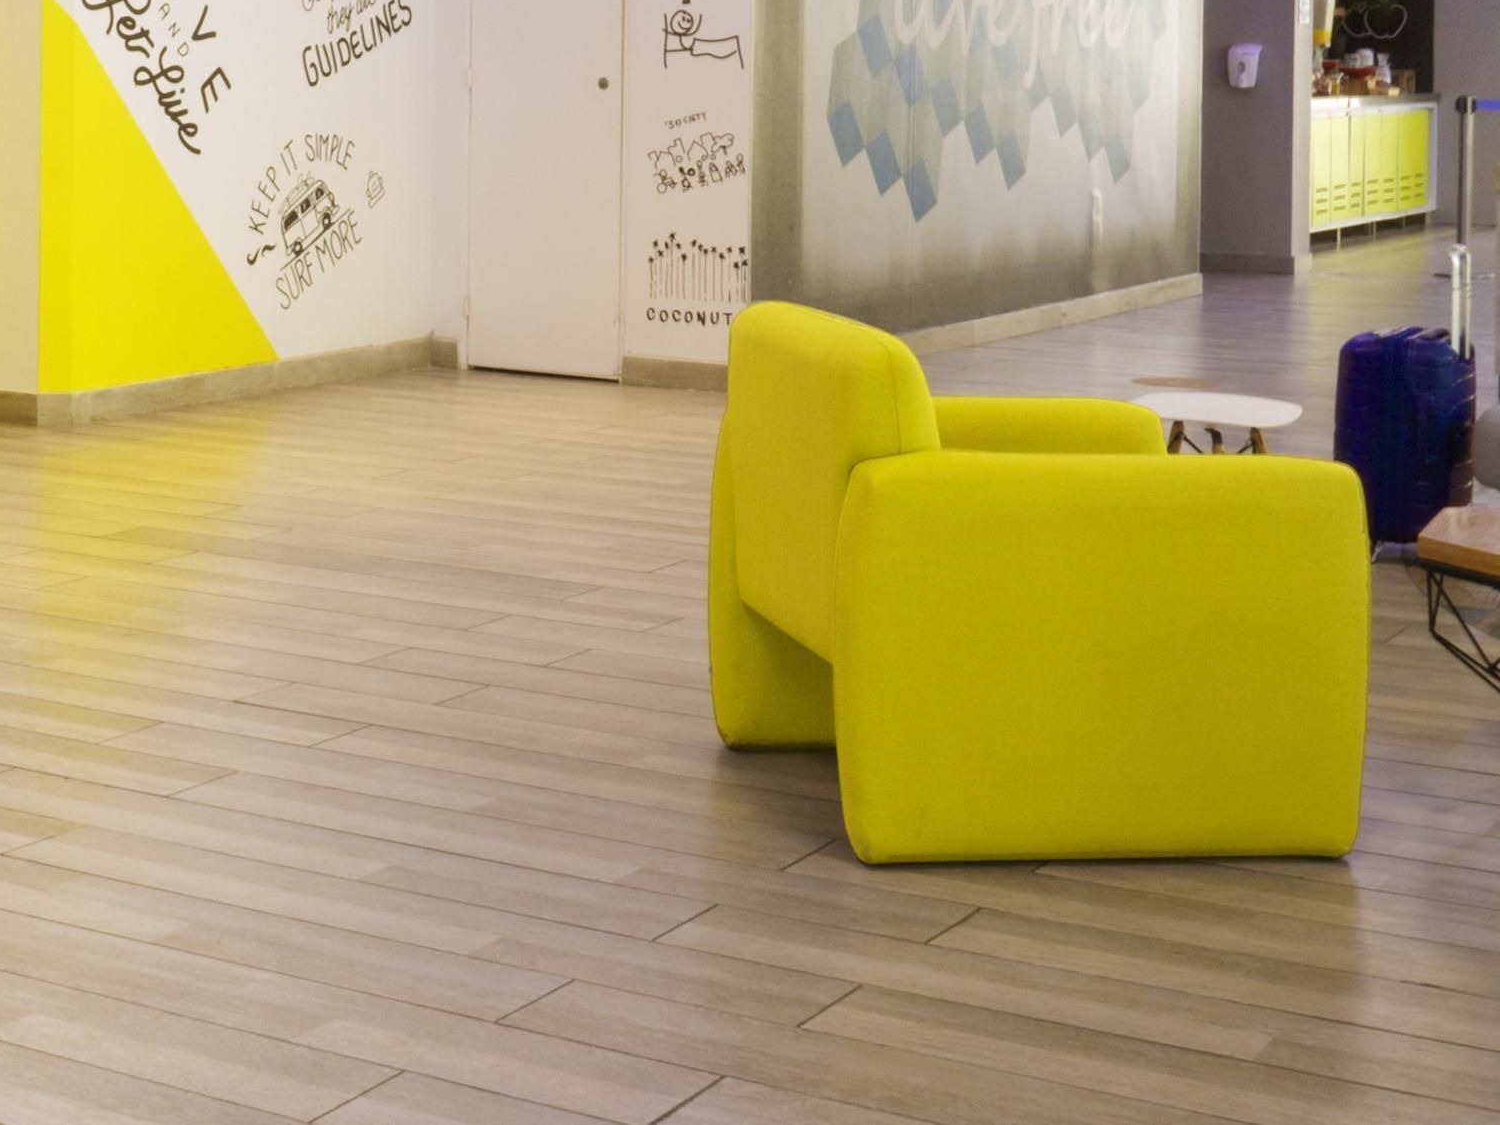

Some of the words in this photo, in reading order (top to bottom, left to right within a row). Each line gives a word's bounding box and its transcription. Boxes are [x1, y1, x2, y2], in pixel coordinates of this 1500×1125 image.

[158, 2, 190, 58] AND
[248, 166, 281, 235] KEEP
[280, 139, 299, 176] IT
[304, 132, 356, 171] SIMPLE
[275, 251, 314, 310] SURF
[315, 210, 363, 274] MORE
